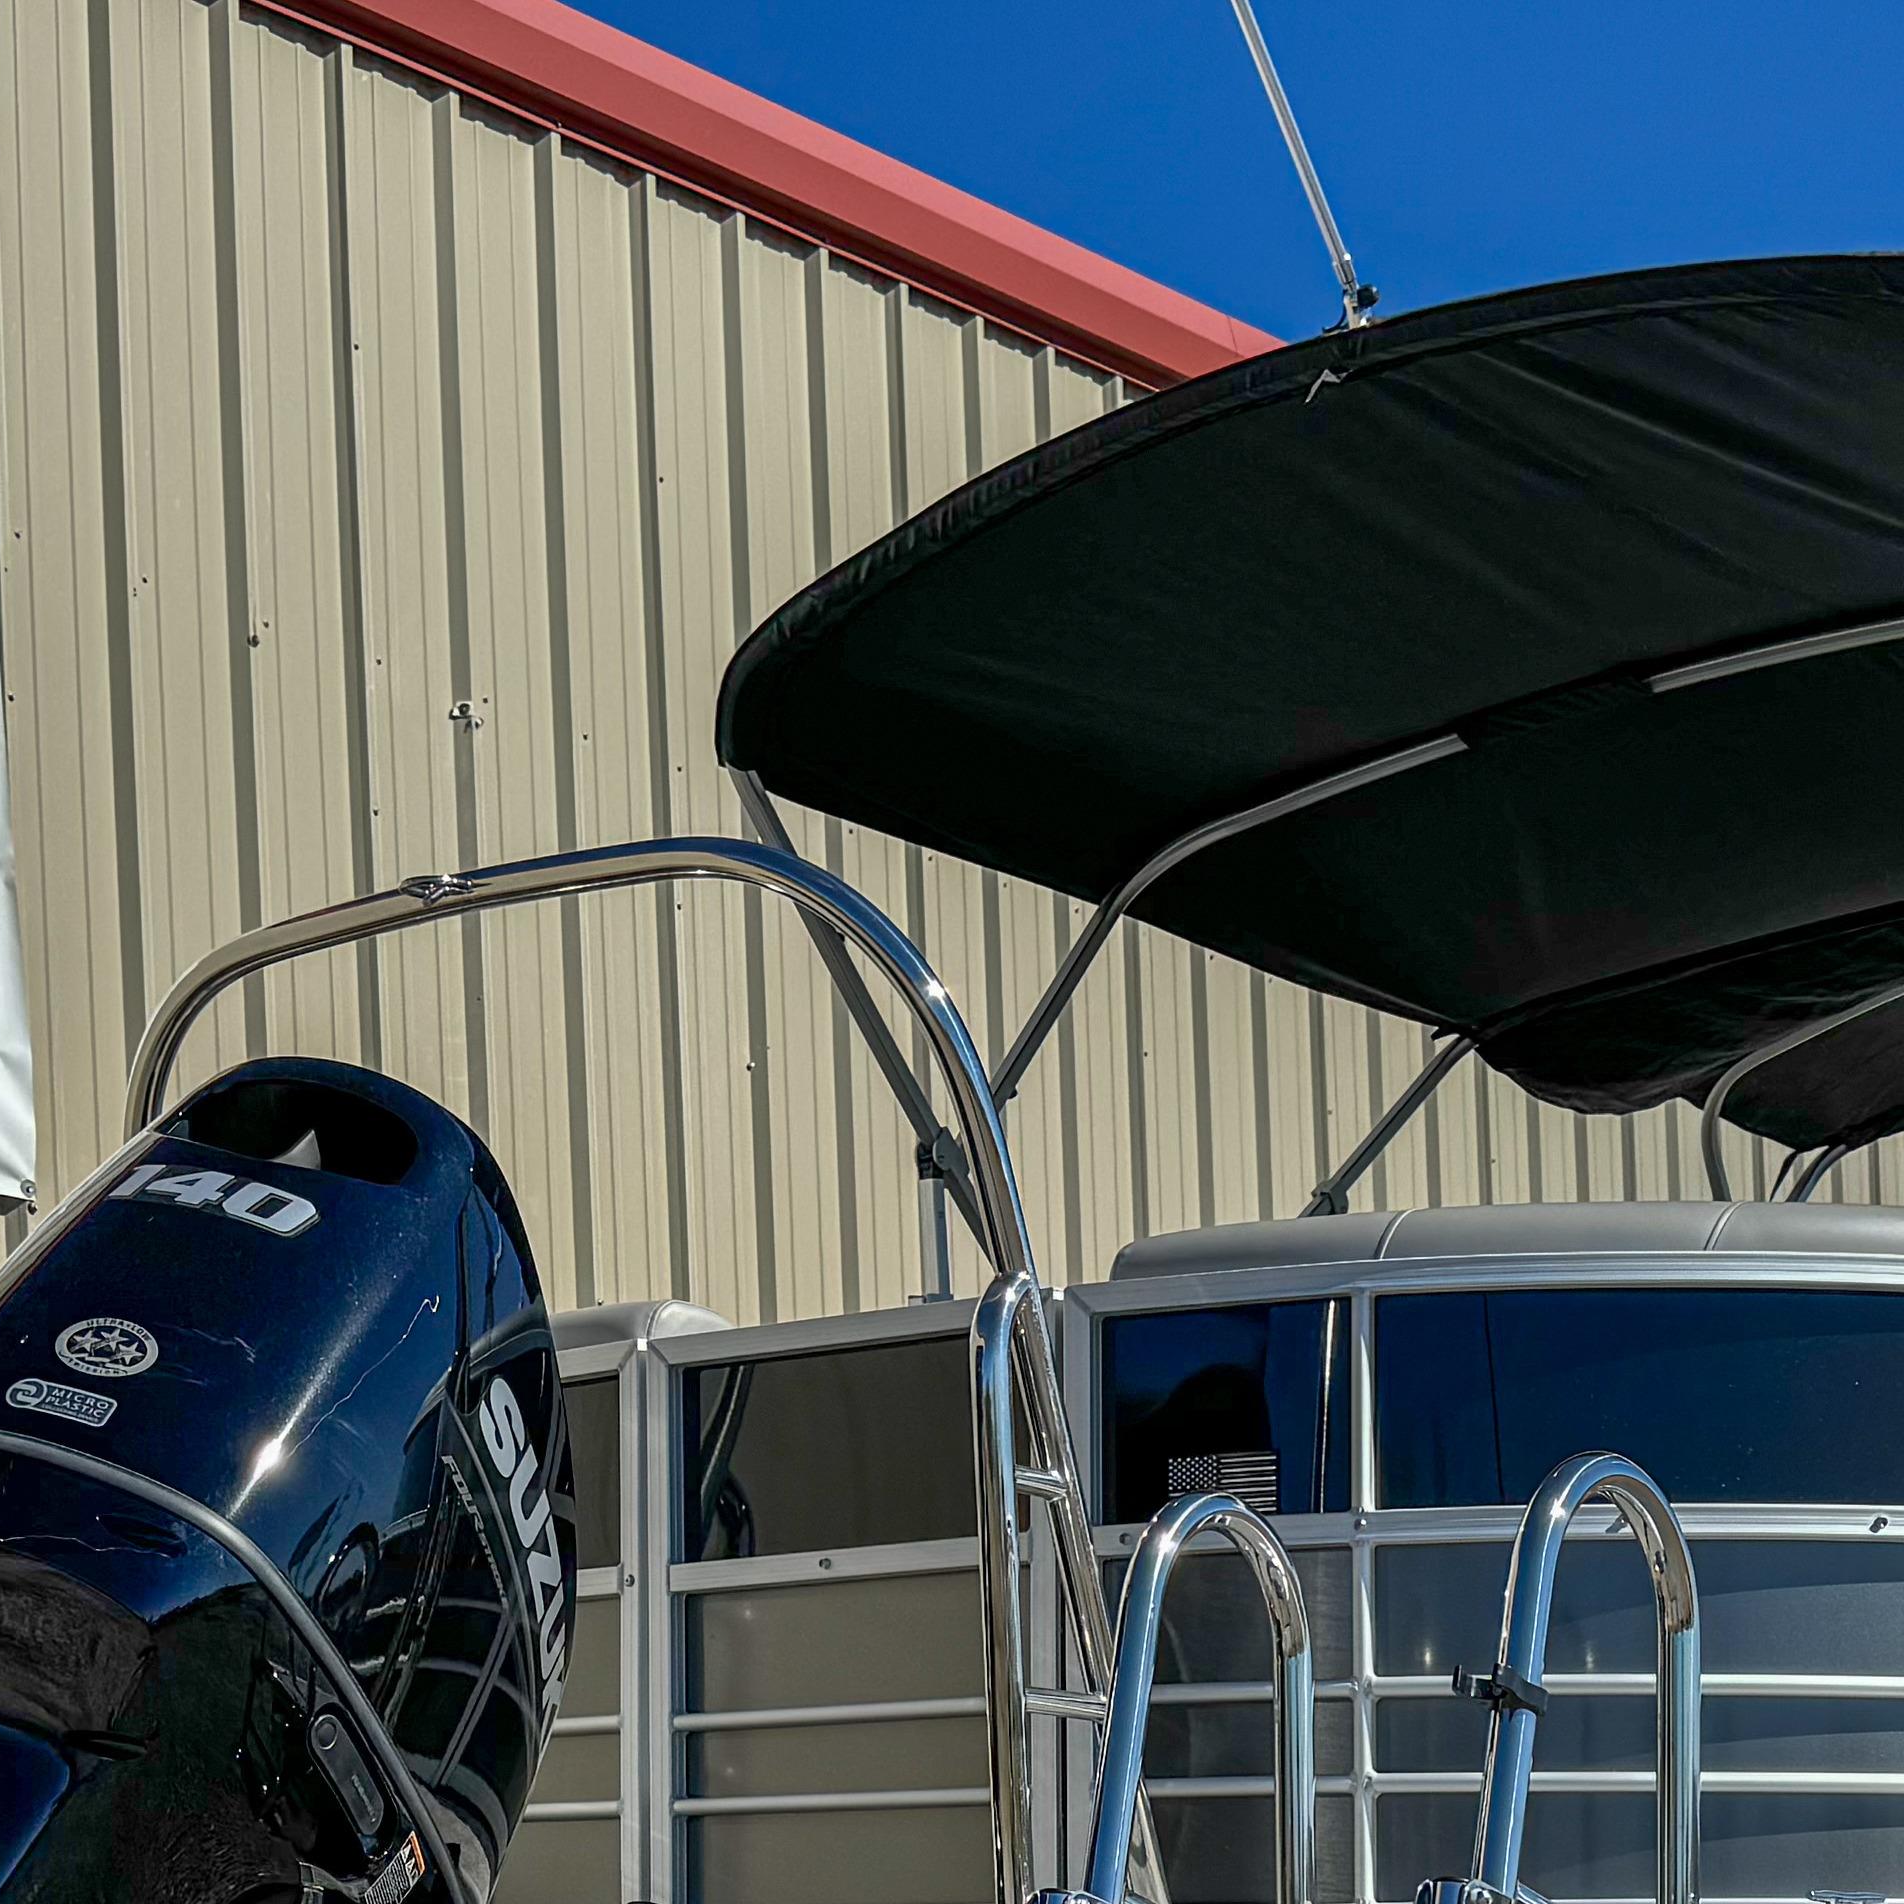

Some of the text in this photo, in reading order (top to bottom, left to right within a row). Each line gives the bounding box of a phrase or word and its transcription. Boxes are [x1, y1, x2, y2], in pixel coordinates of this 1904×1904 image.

[108, 1163, 320, 1236] 140
[45, 1395, 105, 1418] PLASTIC
[52, 1388, 109, 1409] MICRO
[441, 1456, 484, 1533] FOUR
[479, 1377, 566, 1758] SUZUK
